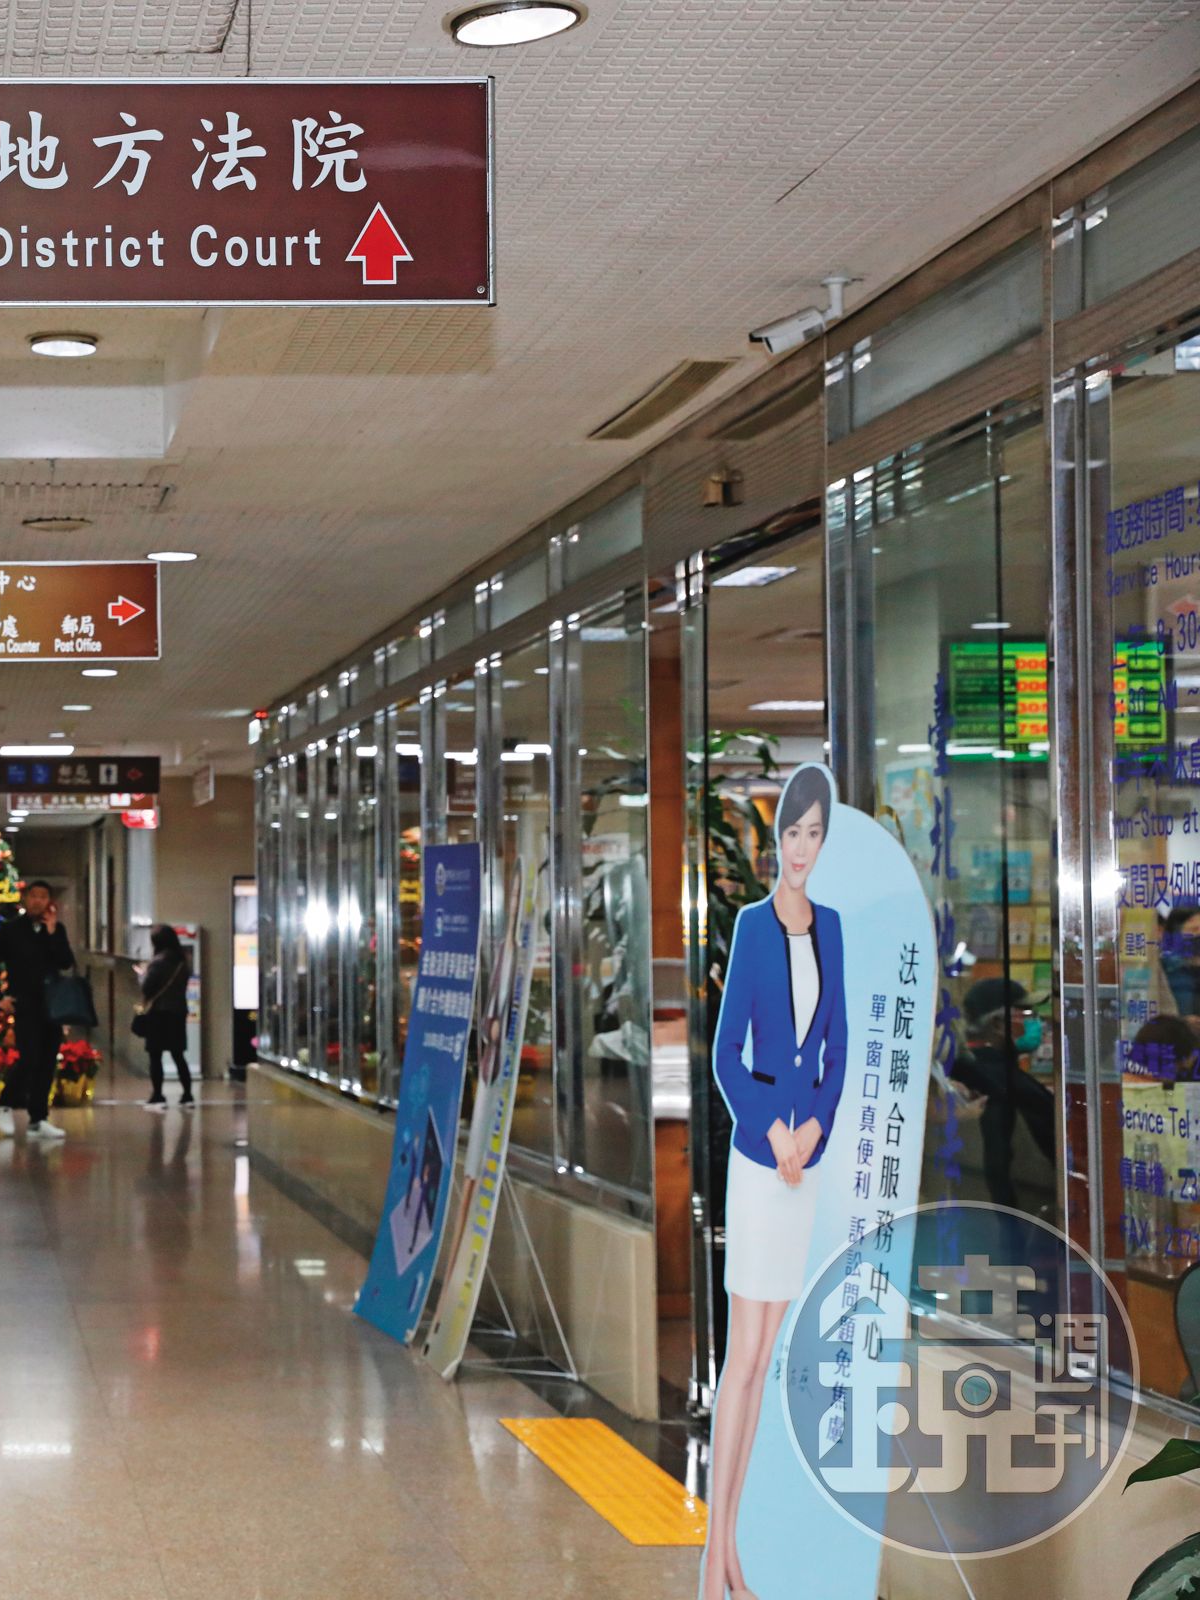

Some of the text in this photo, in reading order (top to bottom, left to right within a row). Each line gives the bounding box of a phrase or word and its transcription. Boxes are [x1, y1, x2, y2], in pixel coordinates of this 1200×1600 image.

[190, 225, 321, 267] Court
[61, 614, 95, 638] 郵局
[7, 639, 41, 653] Counter
[54, 639, 102, 652] Post Office
[853, 993, 888, 1200] 單一窗口真便利
[862, 942, 920, 1361] 法院聯合服務中心
